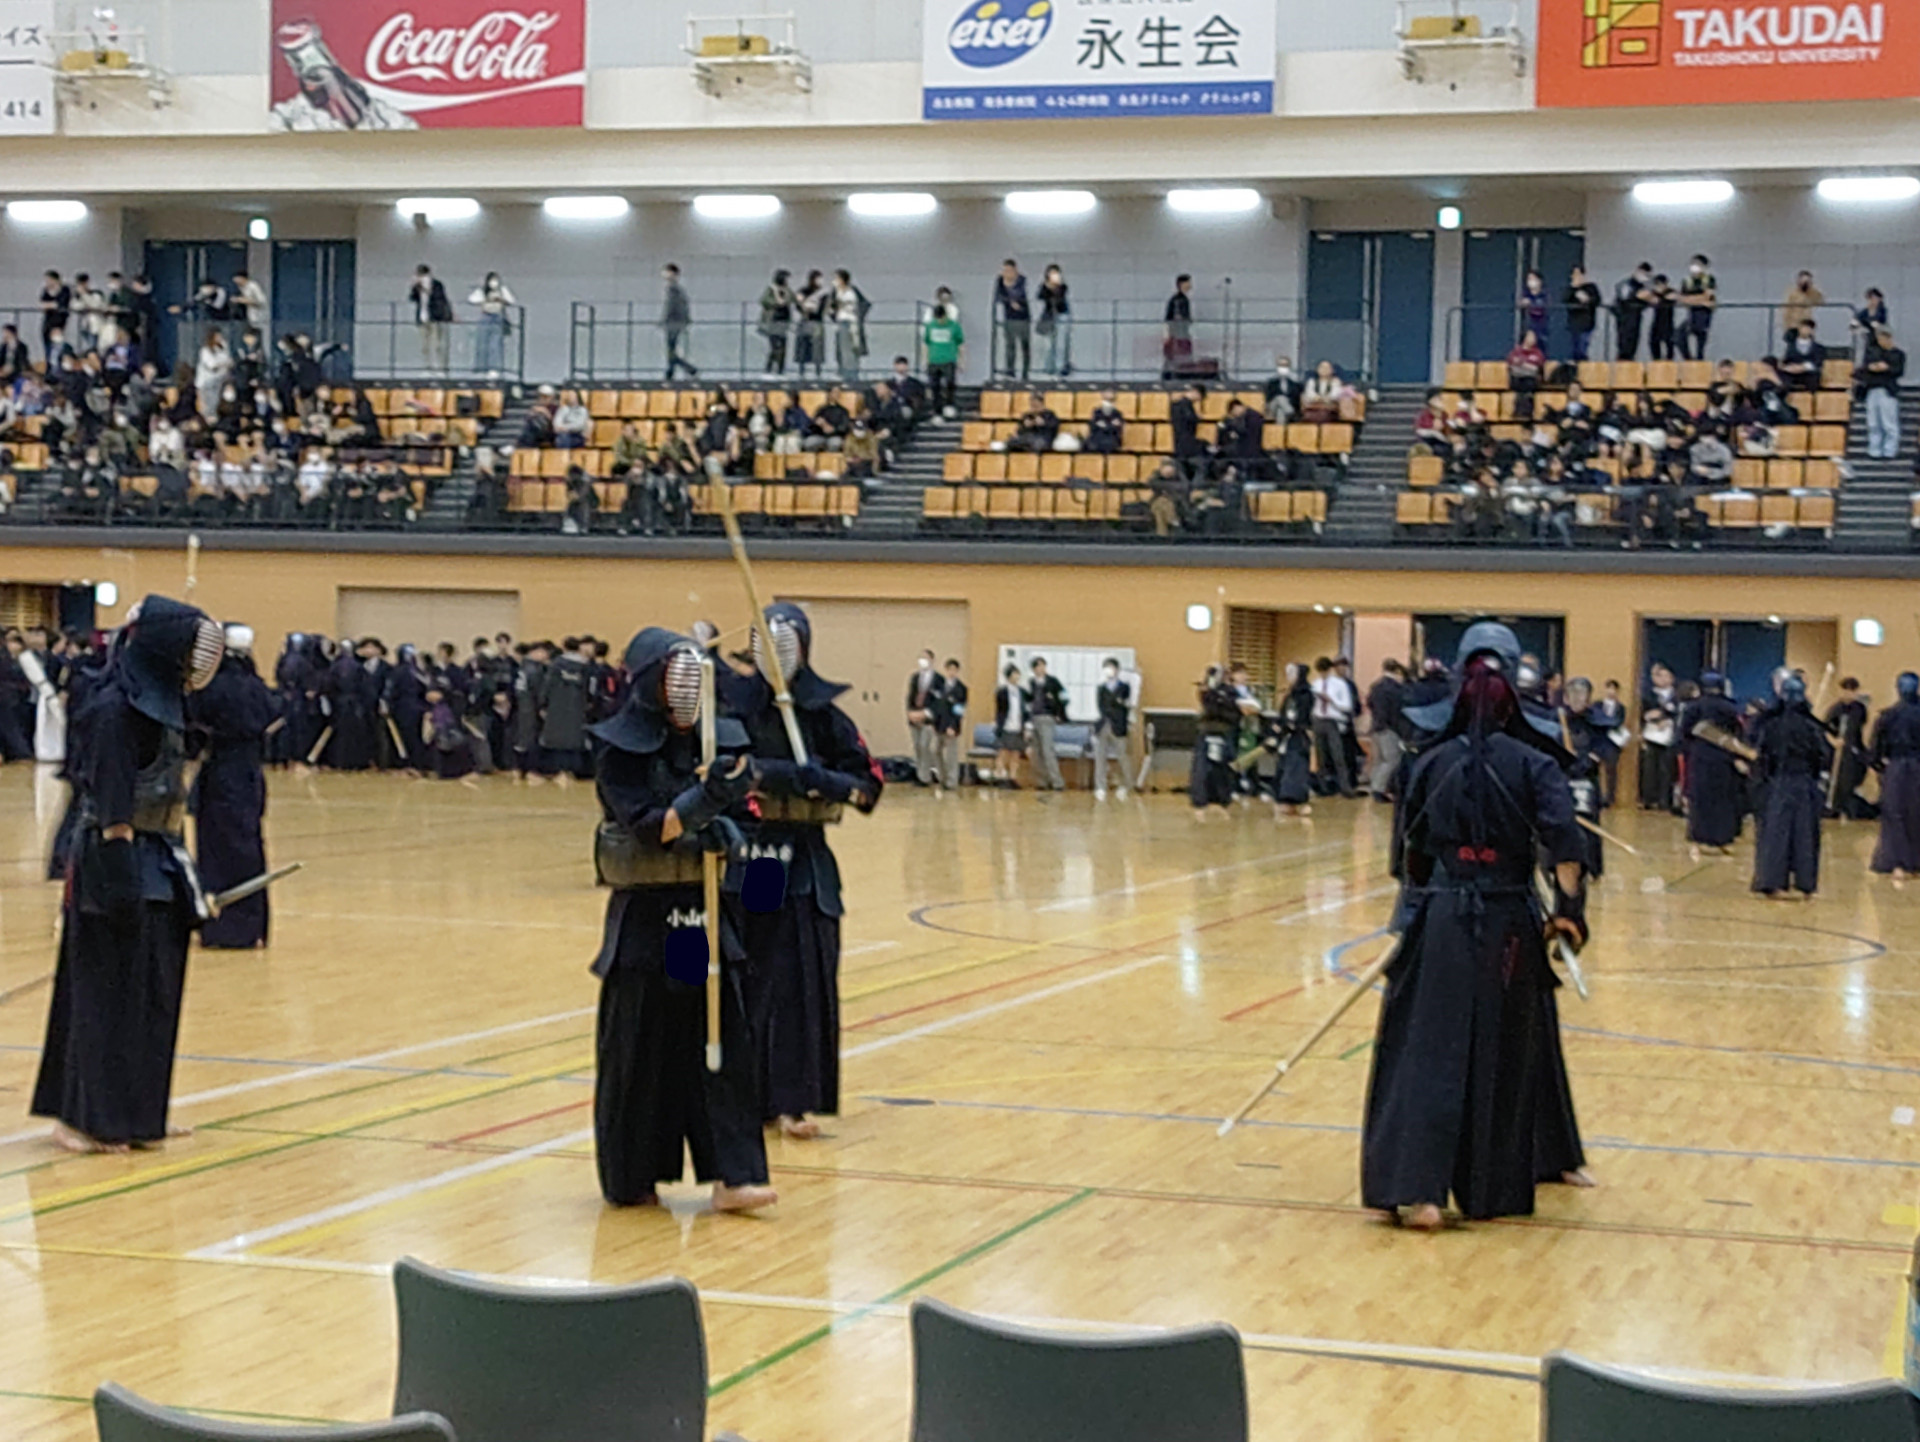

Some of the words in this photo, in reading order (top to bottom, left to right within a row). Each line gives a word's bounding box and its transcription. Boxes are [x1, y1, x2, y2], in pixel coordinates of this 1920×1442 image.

[365, 11, 560, 81] Coca-Cola
[950, 2, 1046, 48] eisei
[1077, 15, 1240, 69] 永生会
[1674, 3, 1884, 48] TAKUDAI
[1673, 50, 1774, 67] TAKUSHOKU
[1778, 46, 1881, 64] UNIVERSITY
[3, 100, 41, 118] 414
